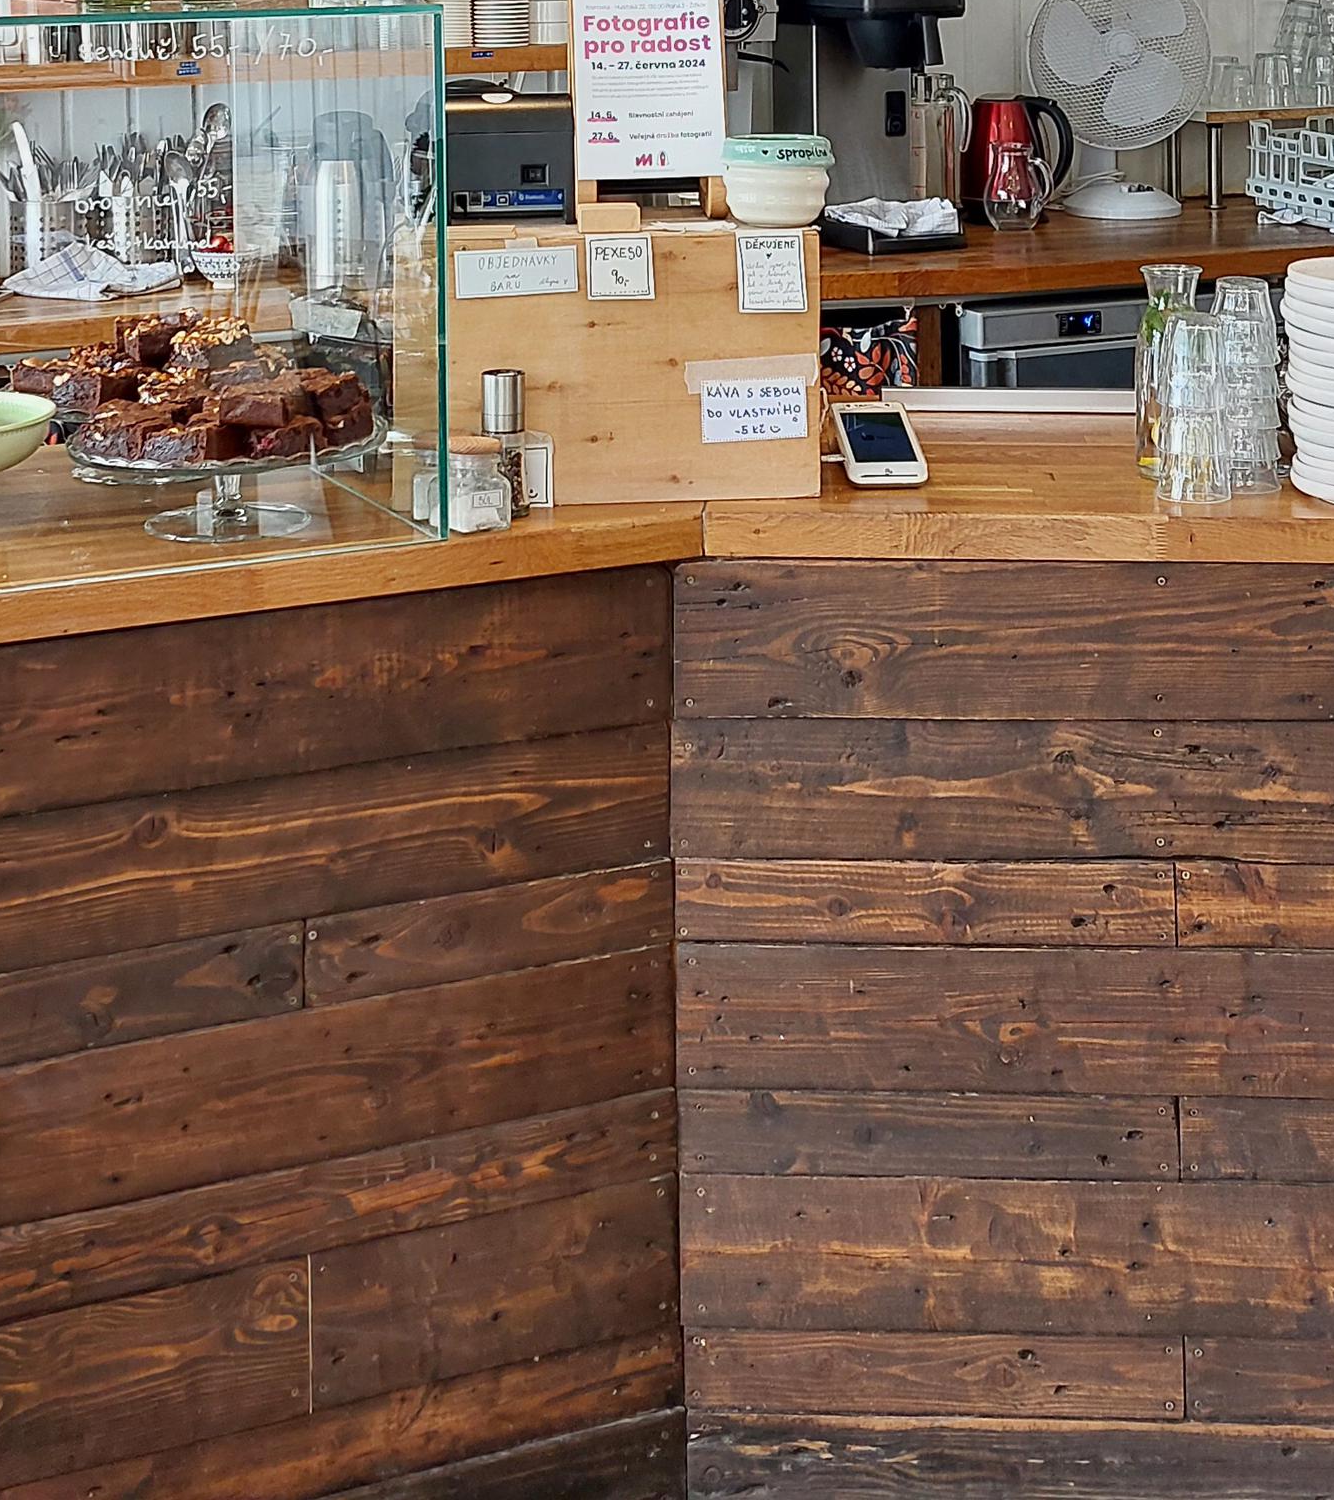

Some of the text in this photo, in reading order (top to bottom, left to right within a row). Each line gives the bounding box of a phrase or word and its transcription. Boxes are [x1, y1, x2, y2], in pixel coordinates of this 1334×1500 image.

[583, 11, 711, 37] Fotografie
[584, 34, 712, 60] pro radost
[617, 61, 633, 70] 27.
[635, 59, 676, 70] června
[678, 58, 706, 69] 2024
[595, 245, 643, 261] PEXESO
[490, 280, 522, 292] BARU
[707, 383, 801, 398] KÁVA S SEBOU
[707, 402, 801, 418] DO VLASTNÍHO
